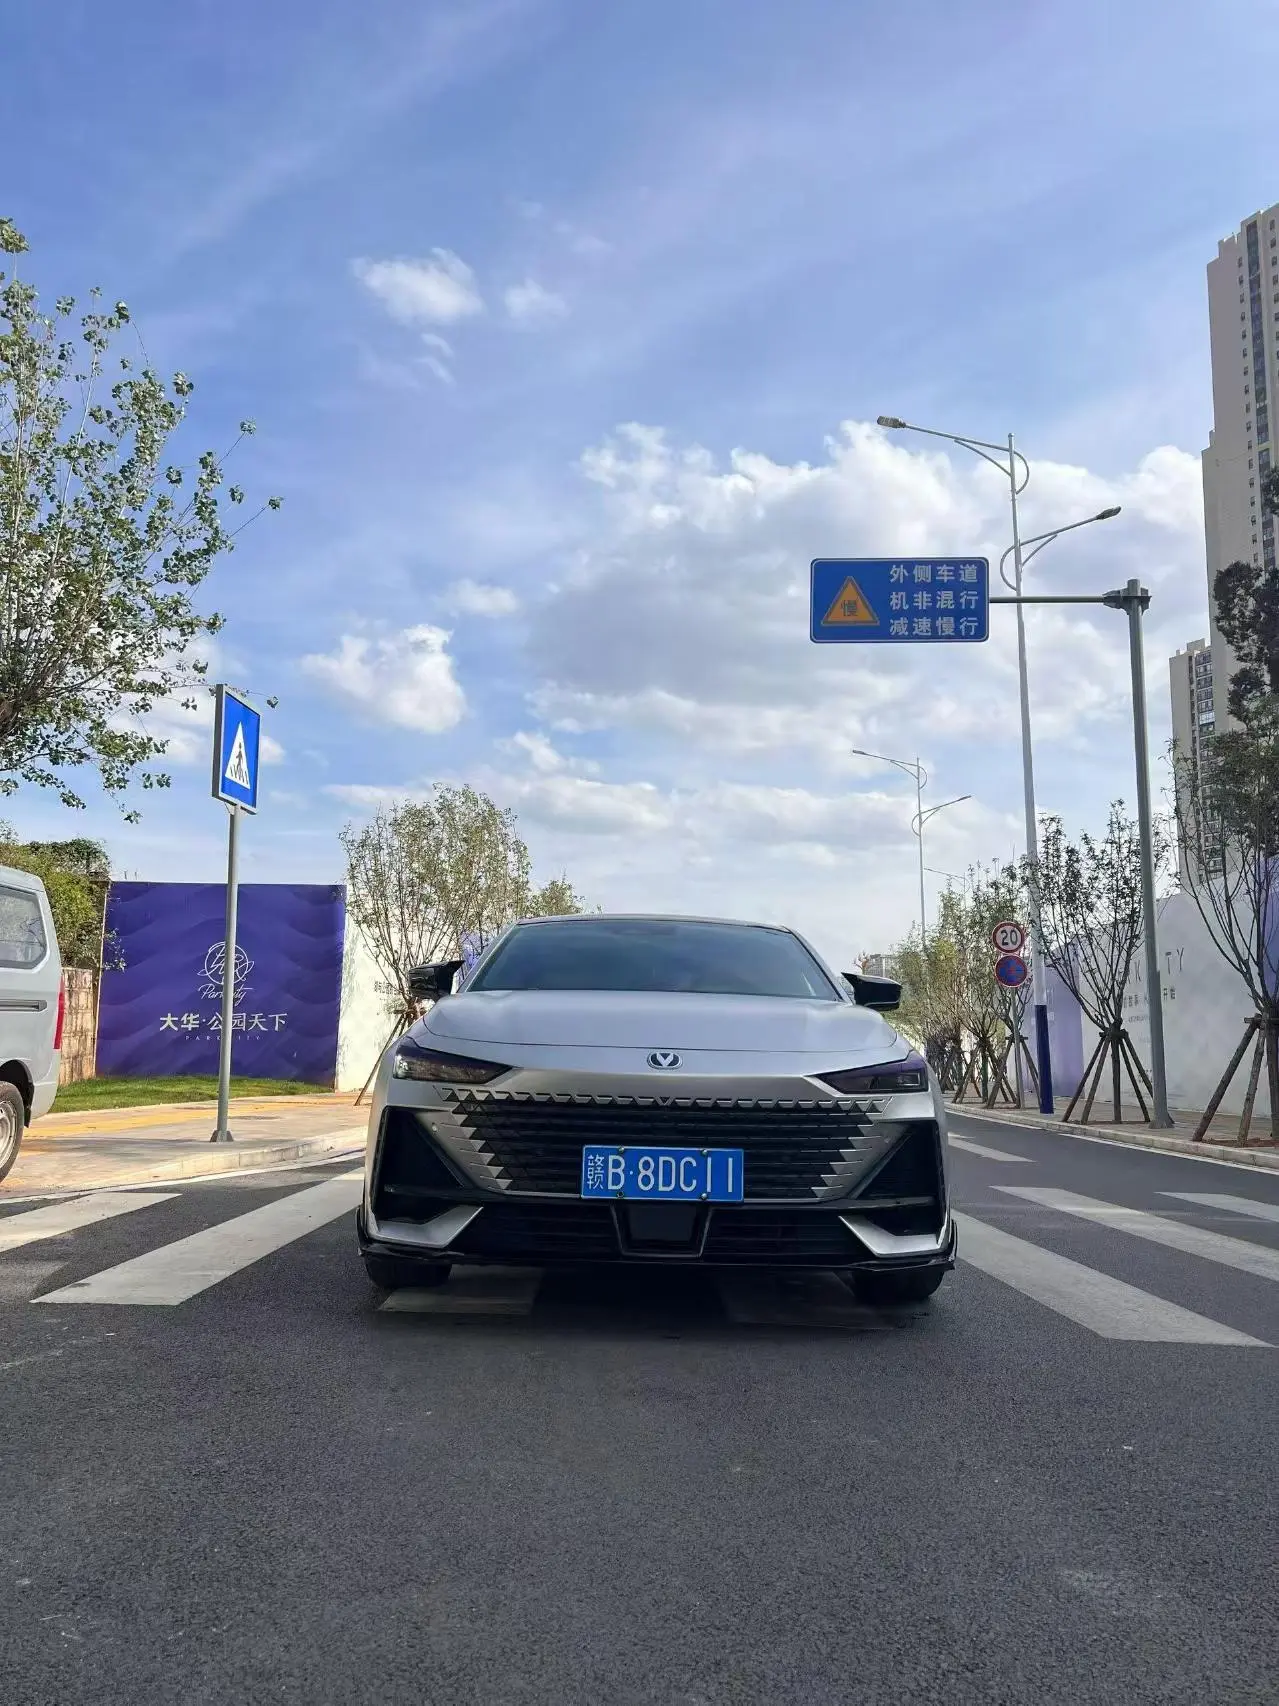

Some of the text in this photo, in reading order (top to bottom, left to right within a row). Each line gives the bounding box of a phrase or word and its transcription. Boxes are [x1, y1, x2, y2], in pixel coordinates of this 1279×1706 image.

[890, 564, 978, 583] 外侧车道
[890, 590, 979, 610] 机非混行
[890, 616, 979, 636] 减速慢行
[1001, 929, 1018, 946] 20
[587, 1154, 733, 1193] 赣B·8DC11
